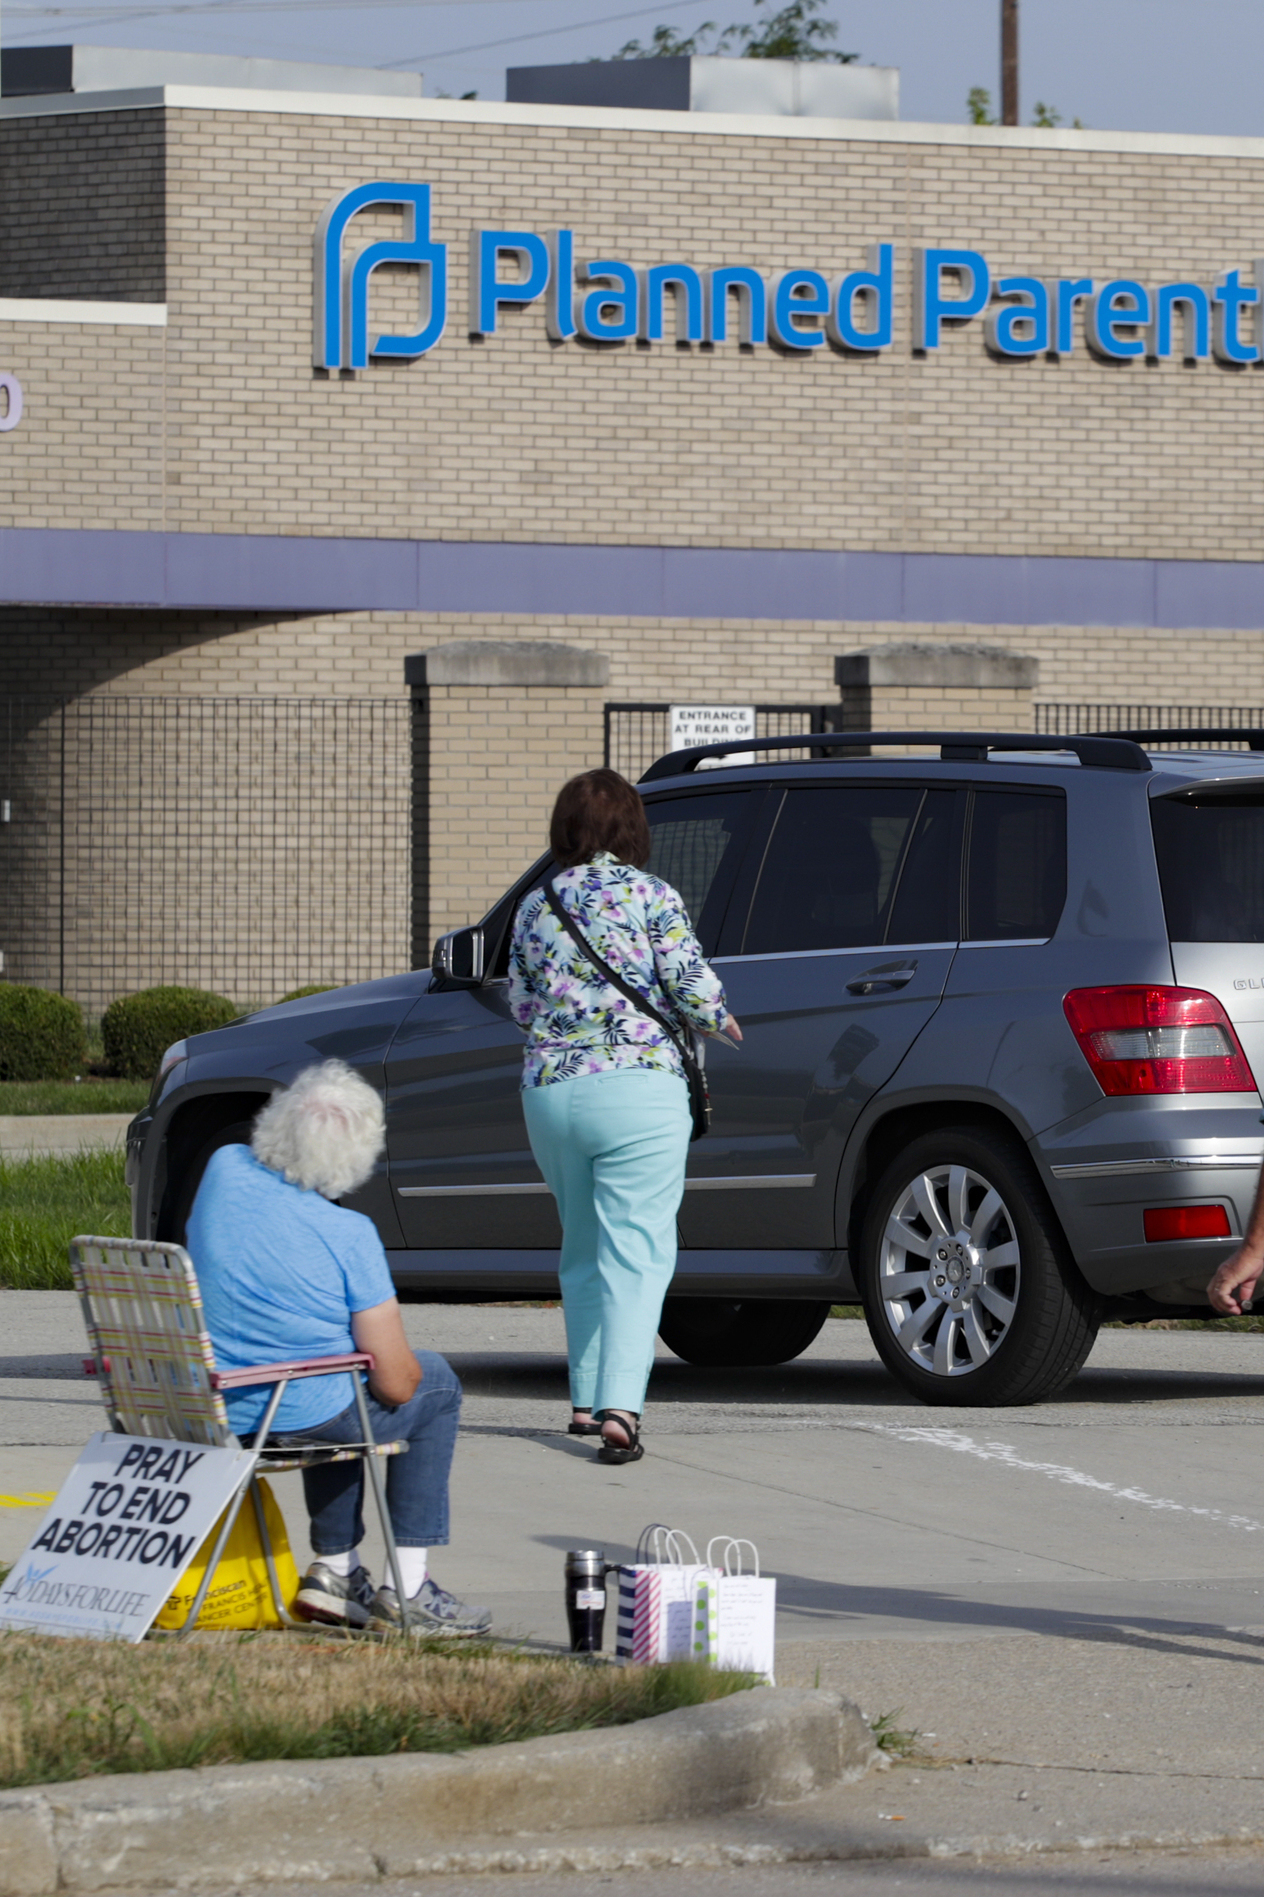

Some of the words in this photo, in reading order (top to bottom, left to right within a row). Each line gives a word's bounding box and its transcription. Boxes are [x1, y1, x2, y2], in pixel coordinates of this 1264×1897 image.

[474, 228, 893, 350] Planned
[674, 724, 690, 734] AT
[695, 724, 729, 734] REAR
[735, 724, 751, 734] OF
[679, 711, 746, 720] ENTRANCE
[684, 738, 742, 747] BUILD
[113, 1443, 206, 1484] PRAY
[80, 1481, 125, 1517] TO
[118, 1486, 191, 1525] END
[30, 1518, 197, 1569] ABORTION
